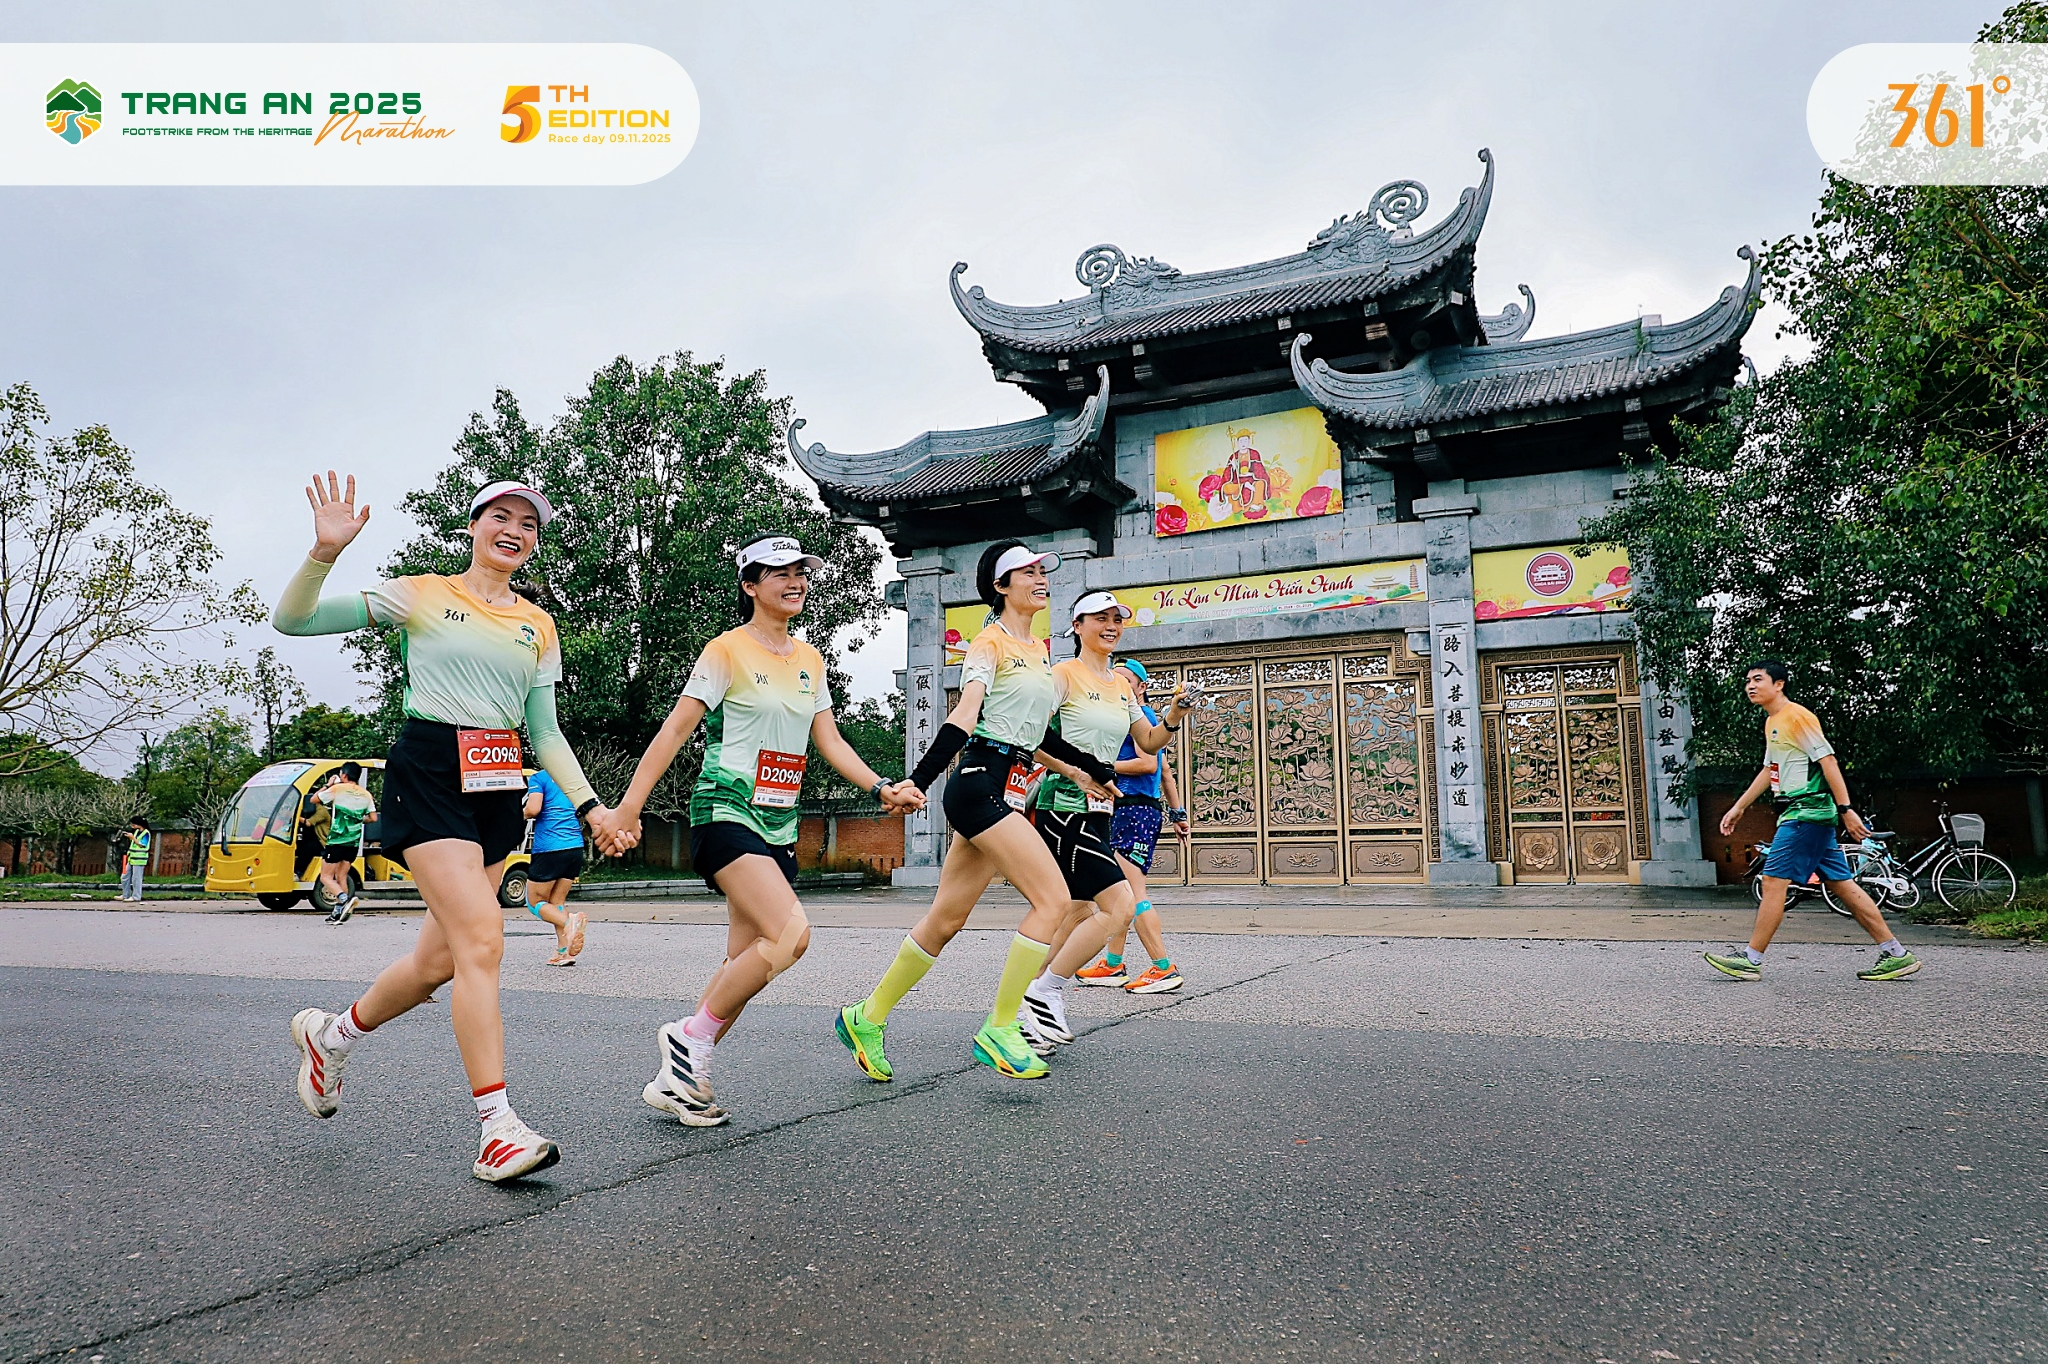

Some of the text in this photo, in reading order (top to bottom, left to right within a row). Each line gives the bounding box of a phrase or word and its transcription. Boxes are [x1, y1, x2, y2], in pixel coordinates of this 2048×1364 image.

[771, 541, 801, 553] Titleis
[1153, 588, 1174, 609] Vu
[1178, 587, 1210, 609] Lan
[1214, 583, 1259, 602] Mùa
[466, 746, 519, 765] C20962
